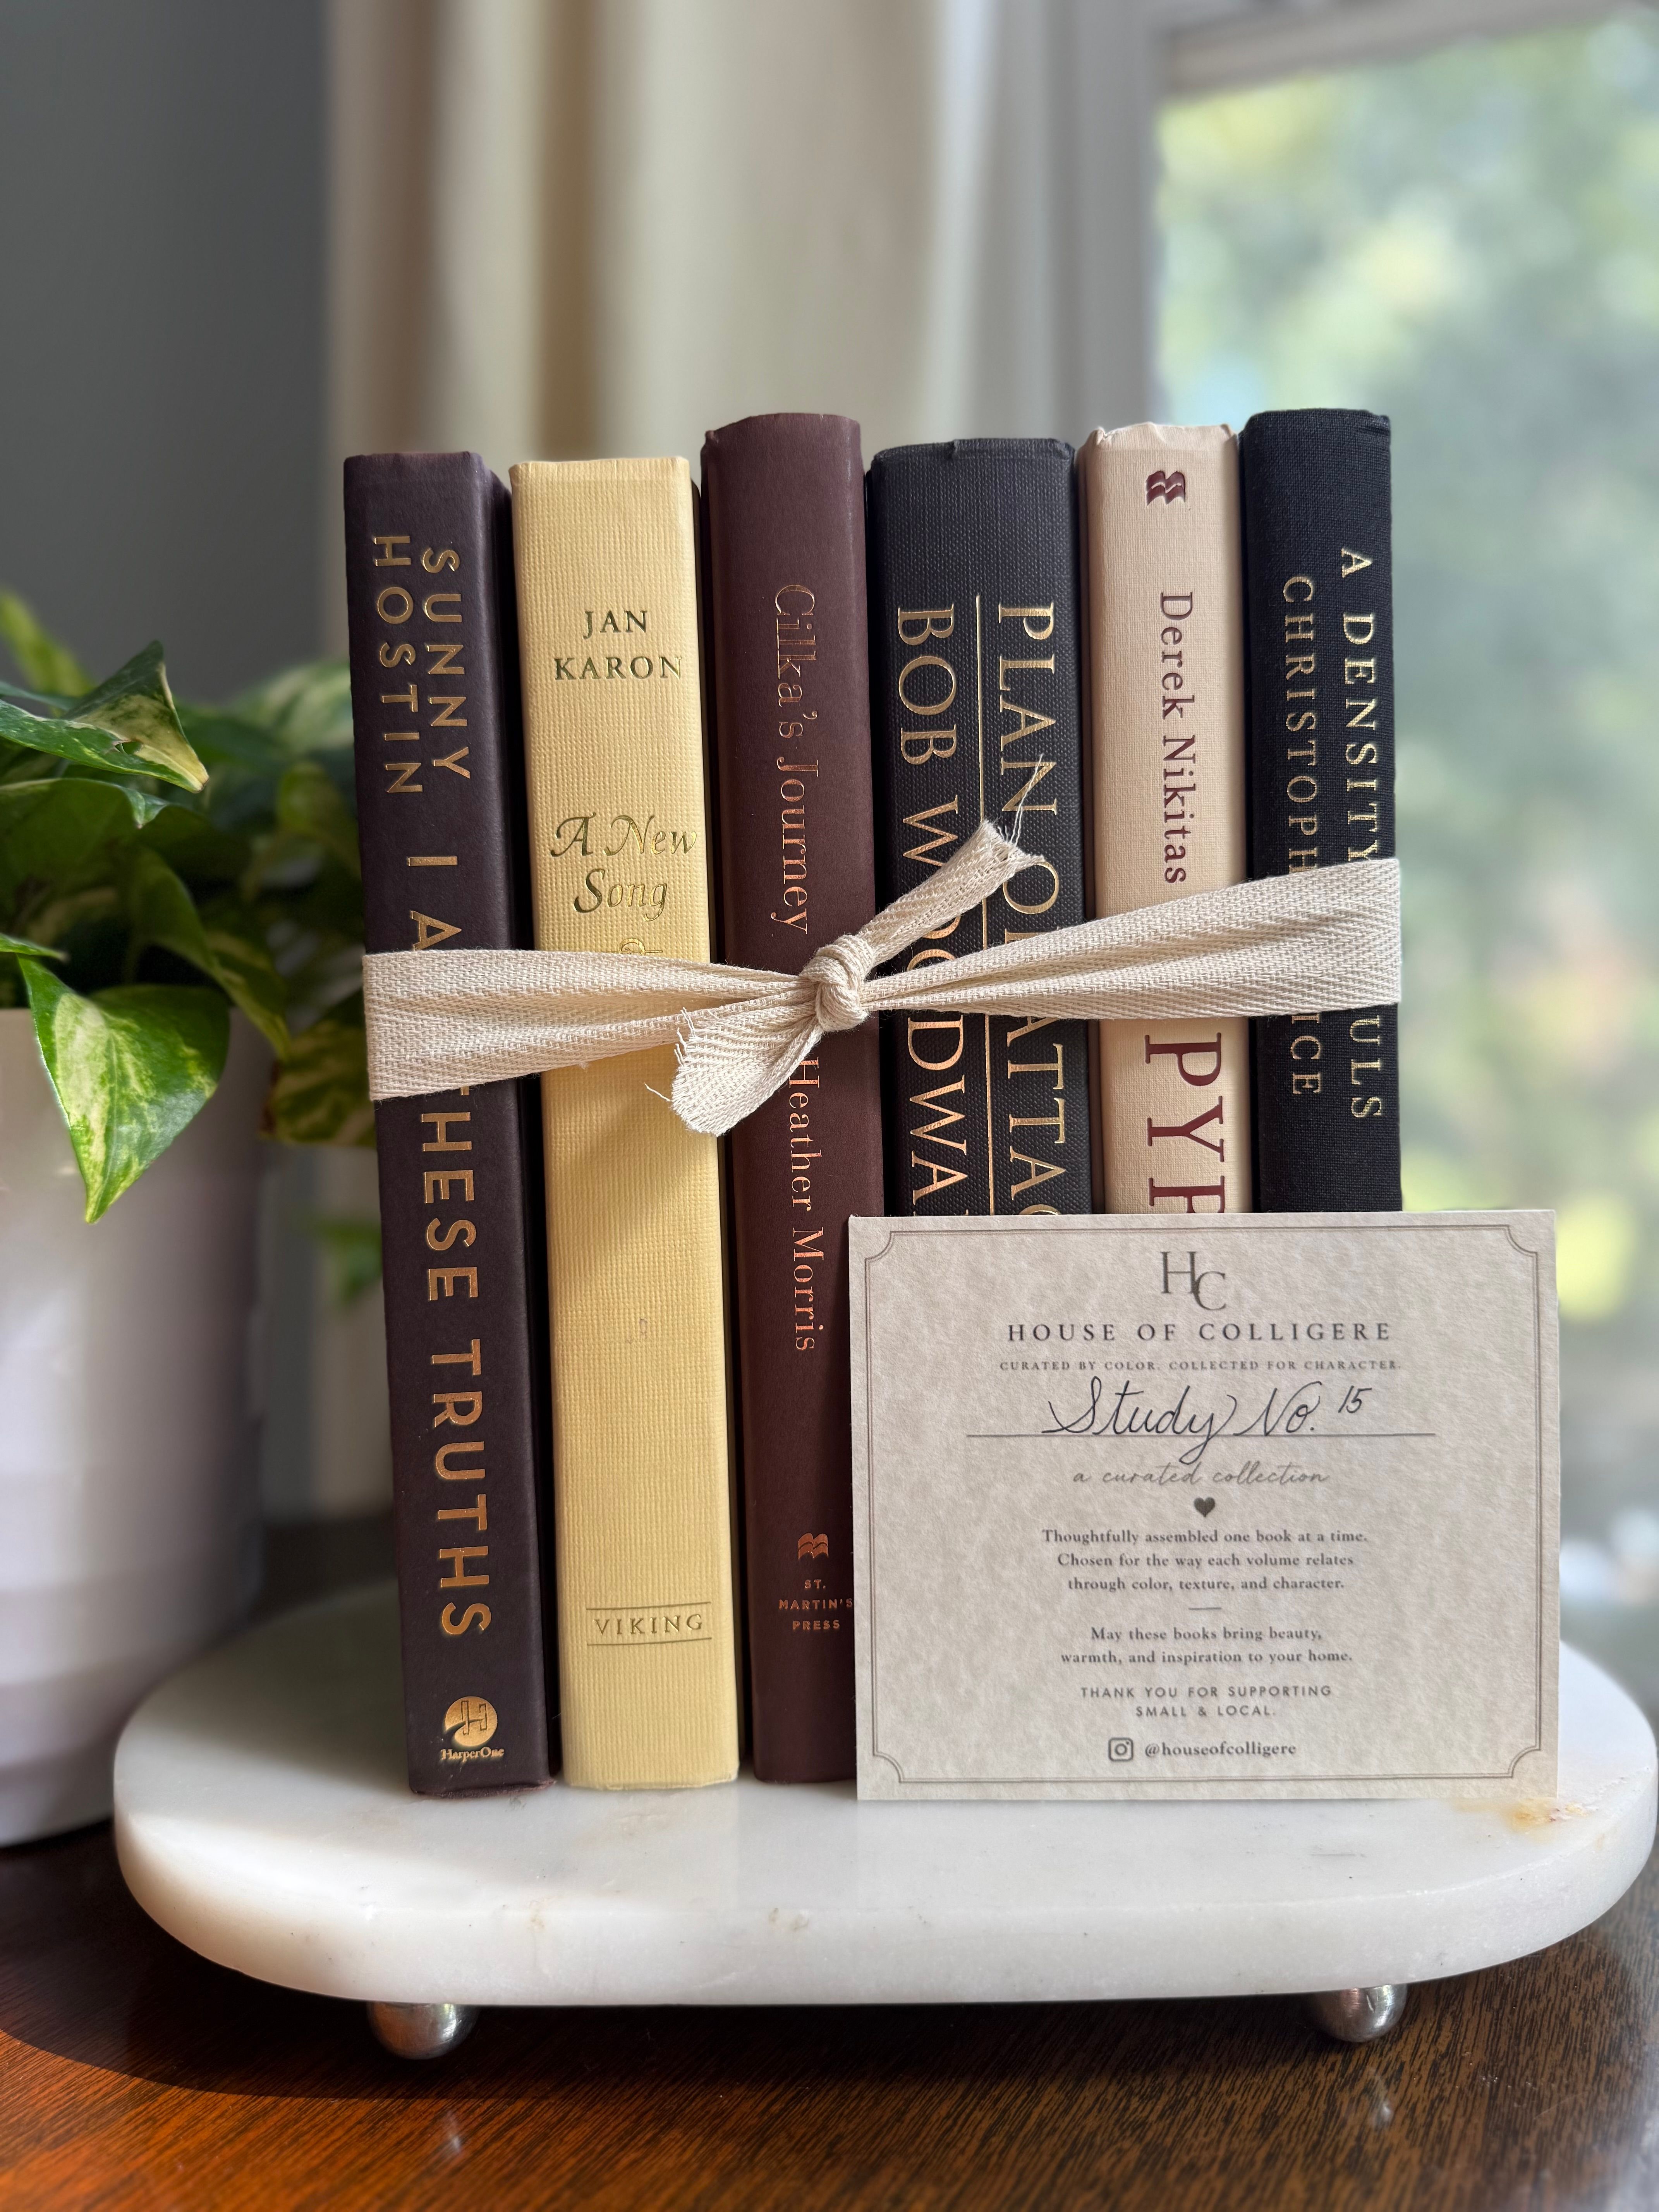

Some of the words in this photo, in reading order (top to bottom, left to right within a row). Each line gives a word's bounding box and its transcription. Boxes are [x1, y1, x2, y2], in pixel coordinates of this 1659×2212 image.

[1341, 547, 1373, 578] A
[583, 610, 647, 640] JAN
[374, 536, 423, 793] HOSTIN
[422, 547, 470, 779] SUNNY
[554, 656, 682, 680] KARON
[775, 584, 818, 738] Cilka's
[1161, 592, 1195, 720] Derek
[898, 603, 957, 765] BOB
[998, 602, 1057, 815] PLAN
[1283, 576, 1318, 873] CHRISTOPH
[1343, 612, 1378, 861] DENSITY
[1163, 735, 1196, 884] Nikitas
[550, 812, 597, 857] A
[603, 814, 697, 856] New
[771, 757, 818, 934] Journey
[407, 856, 458, 866] I
[573, 868, 667, 922] Song
[410, 910, 462, 951] A
[1290, 1015, 1321, 1095] ICE
[789, 1056, 822, 1211] Heather
[421, 1085, 479, 1301] HESE
[793, 1227, 824, 1350] Morris
[1008, 1324, 1115, 1341] HOUSE
[1137, 1323, 1176, 1340] OF
[1199, 1322, 1389, 1340] COLLIGERE
[1000, 1361, 1070, 1370] CURATED
[1079, 1361, 1096, 1370] BY
[1105, 1361, 1161, 1370] COLOR.
[1169, 1361, 1258, 1370] COLLECTED
[1267, 1361, 1296, 1370] FOR
[1304, 1360, 1401, 1370] CHARACTER.
[1041, 1376, 1237, 1465] Study
[1233, 1381, 1322, 1436] No.
[1338, 1385, 1372, 1413] 15
[431, 1339, 492, 1635] TRUTHS
[1073, 1472, 1089, 1482] a
[1103, 1462, 1202, 1485] curated
[1212, 1460, 1329, 1485] collection
[1042, 1529, 1139, 1545] Thoughtfully
[1145, 1530, 1218, 1542] assembled
[1224, 1534, 1250, 1542] one
[1256, 1530, 1291, 1542] book
[1298, 1532, 1310, 1542] at
[1317, 1534, 1324, 1542] a
[1331, 1530, 1367, 1542] time.
[1058, 1553, 1113, 1566] Chosen
[1119, 1553, 1140, 1566] for
[1146, 1553, 1169, 1566] the
[1175, 1558, 1202, 1569] way
[1208, 1553, 1240, 1566] each
[1247, 1553, 1300, 1565] volume
[1306, 1553, 1354, 1565] relates
[805, 1579, 826, 1589] ST.
[1068, 1577, 1125, 1592] through
[1132, 1577, 1173, 1590] color,
[1180, 1580, 1235, 1590] texture,
[1241, 1577, 1267, 1589] and
[1273, 1577, 1345, 1589] character.
[779, 1598, 852, 1609] MARTIN'S
[593, 1614, 702, 1635] VIKING
[793, 1620, 840, 1630] PRESS
[1091, 1628, 1122, 1641] May
[1129, 1628, 1167, 1640] these
[1174, 1628, 1217, 1640] books
[1223, 1627, 1263, 1640] bring
[1269, 1626, 1322, 1641] beauty,
[1061, 1650, 1122, 1664] warmth,
[1128, 1650, 1155, 1663] and
[1162, 1651, 1242, 1665] inspiration
[1249, 1653, 1263, 1662] to
[1269, 1654, 1302, 1664] your
[1309, 1650, 1352, 1661] home.
[1081, 1687, 1135, 1698] THANK
[1145, 1687, 1177, 1698] YOU
[1188, 1686, 1218, 1697] FOR
[1228, 1686, 1331, 1697] SUPPORTING
[1136, 1706, 1187, 1717] SMALL
[1198, 1706, 1207, 1716] &
[1218, 1705, 1276, 1716] LOCAL.
[440, 1747, 505, 1762] HarperOne
[1145, 1741, 1296, 1757] @houseofcolligere
